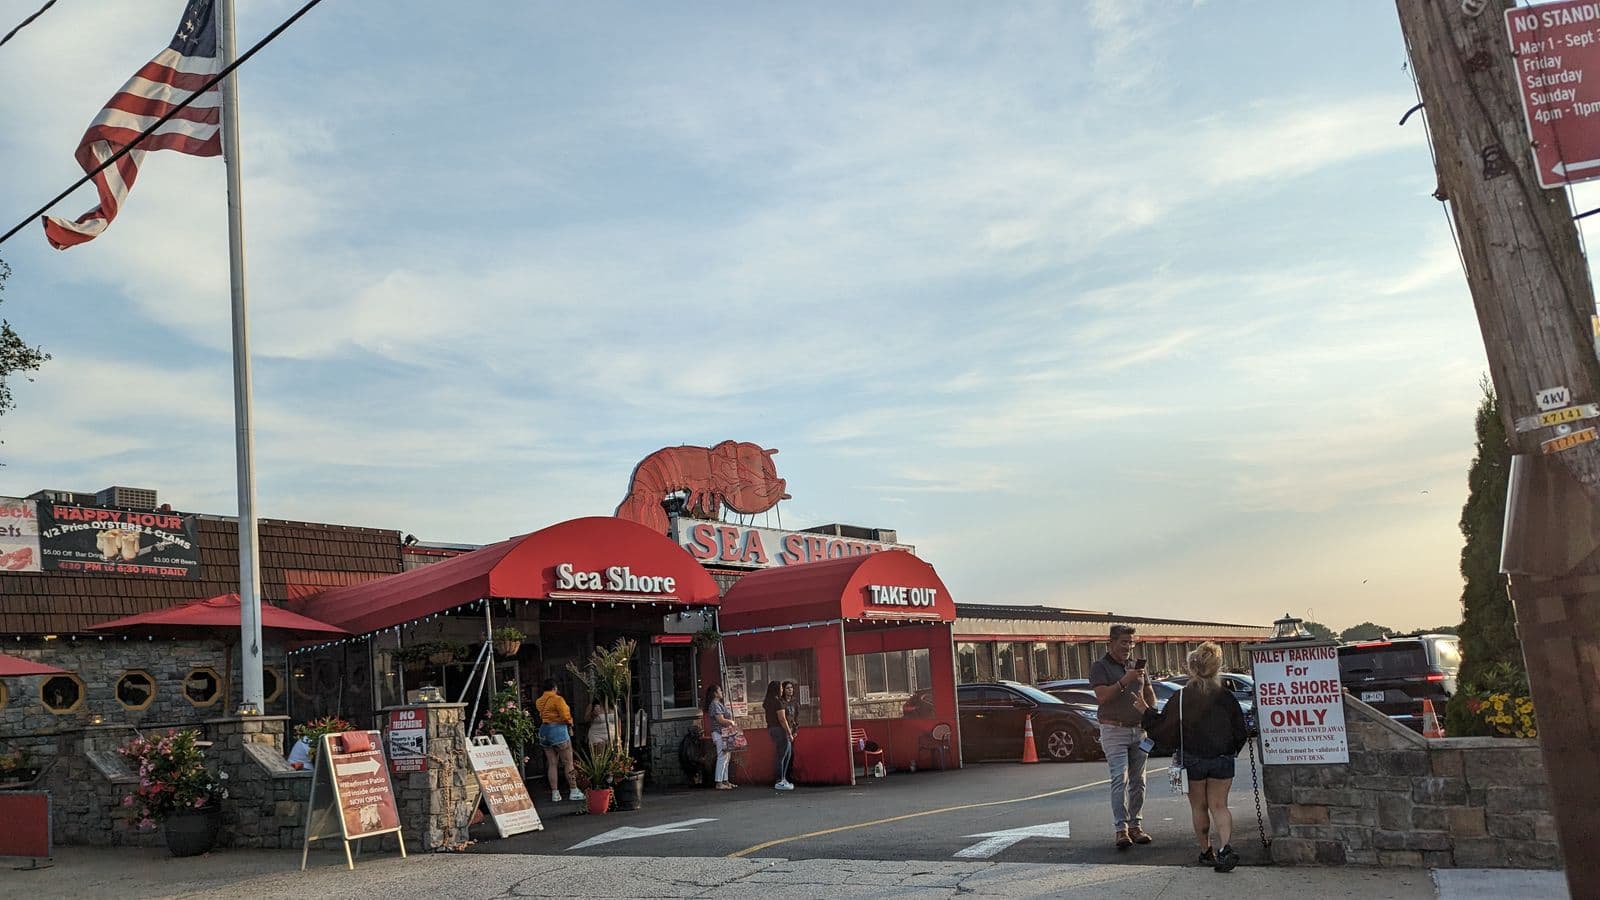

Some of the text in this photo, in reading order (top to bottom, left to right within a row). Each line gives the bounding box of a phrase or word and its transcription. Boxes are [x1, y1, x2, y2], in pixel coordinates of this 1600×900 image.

[1515, 4, 1600, 32] NO STANDI
[1520, 41, 1545, 55] May
[1548, 37, 1554, 50] 1
[1565, 30, 1594, 47] Sept
[1523, 55, 1562, 72] Friday
[1527, 69, 1582, 88] Saturday
[1530, 88, 1576, 105] Sunday
[1535, 107, 1562, 124] 4pm
[1573, 101, 1600, 117] 11pm
[1542, 391, 1565, 405] 4kV
[1542, 408, 1582, 424] X7141
[53, 506, 182, 529] HAPPY HOUR
[43, 521, 191, 550] 1/2 Price OYSTERS & CLAMS
[688, 523, 768, 563] SEA
[84, 563, 101, 571] PM
[117, 565, 140, 573] 6:30
[142, 566, 158, 574] PM
[160, 568, 188, 576] DAILY
[557, 563, 676, 593] Sea Shore
[869, 584, 937, 607] TAKE OUT
[1253, 647, 1336, 663] VALET PARKING
[1285, 665, 1308, 676] For
[1260, 680, 1339, 696] SEA SHORE
[1260, 694, 1339, 706] RESTAURANT
[400, 711, 415, 720] NO
[1270, 709, 1327, 727] ONLY
[369, 786, 389, 794] dining
[486, 783, 514, 793] Shrimp
[349, 795, 383, 806] NOW OPEN
[490, 793, 529, 805] the Basket
